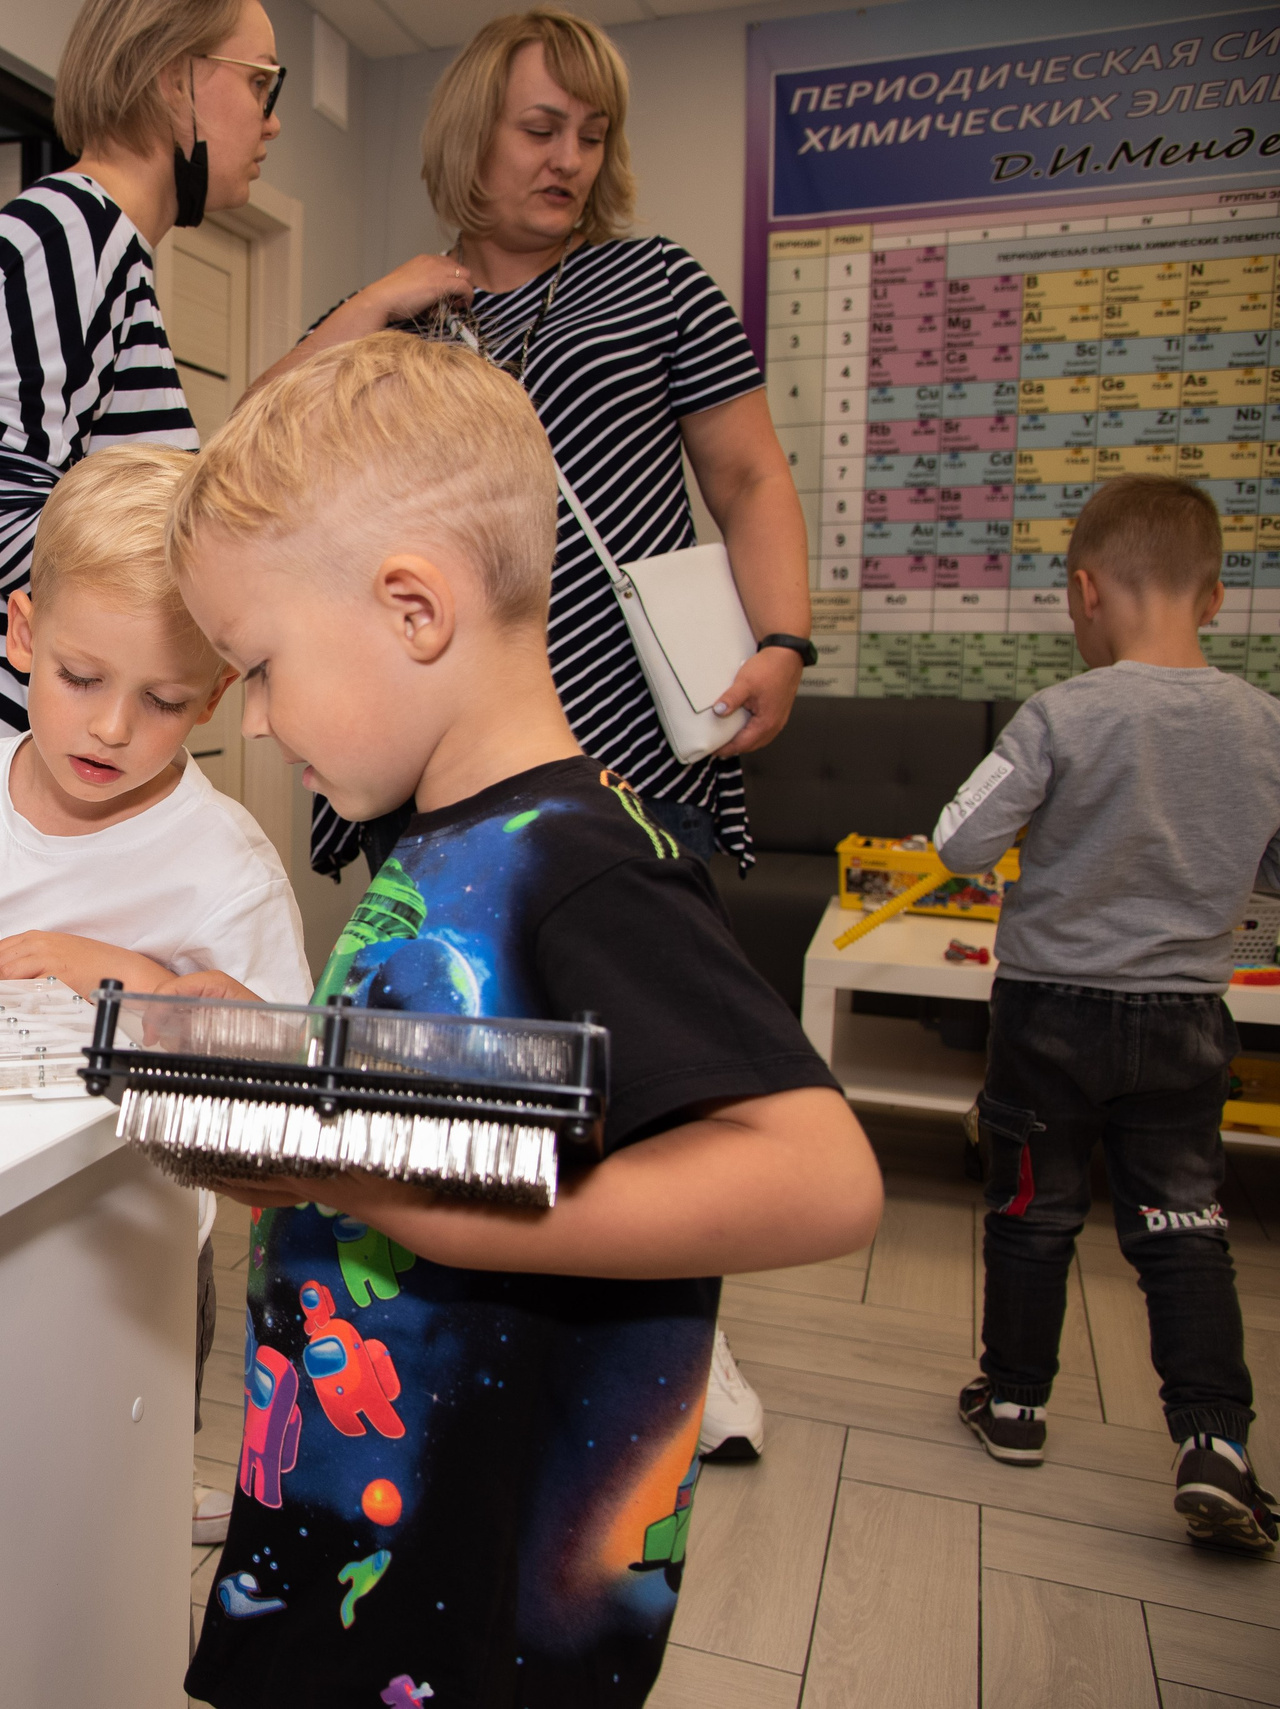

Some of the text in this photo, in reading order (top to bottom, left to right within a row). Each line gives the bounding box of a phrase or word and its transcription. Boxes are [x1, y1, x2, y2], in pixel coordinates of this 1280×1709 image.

[788, 36, 1203, 115] ПЕРИОДИЧЕСКАЯ
[797, 91, 1122, 155] ХИМИЧЕСКИХ
[1090, 242, 1142, 255] СИСТЕМА
[1145, 235, 1219, 251] ХИМИЧЕСКИХ
[1106, 269, 1119, 283] C
[1191, 263, 1205, 276] N
[1189, 300, 1201, 314] P
[947, 316, 972, 331] Mg
[1164, 338, 1181, 351] Ti
[1254, 332, 1267, 347] V
[1184, 373, 1208, 386] As
[1235, 407, 1262, 421] Nb
[1180, 445, 1205, 460] Sb
[1226, 553, 1252, 568] Db
[831, 566, 849, 581] 10
[964, 765, 1008, 809] NOTHING
